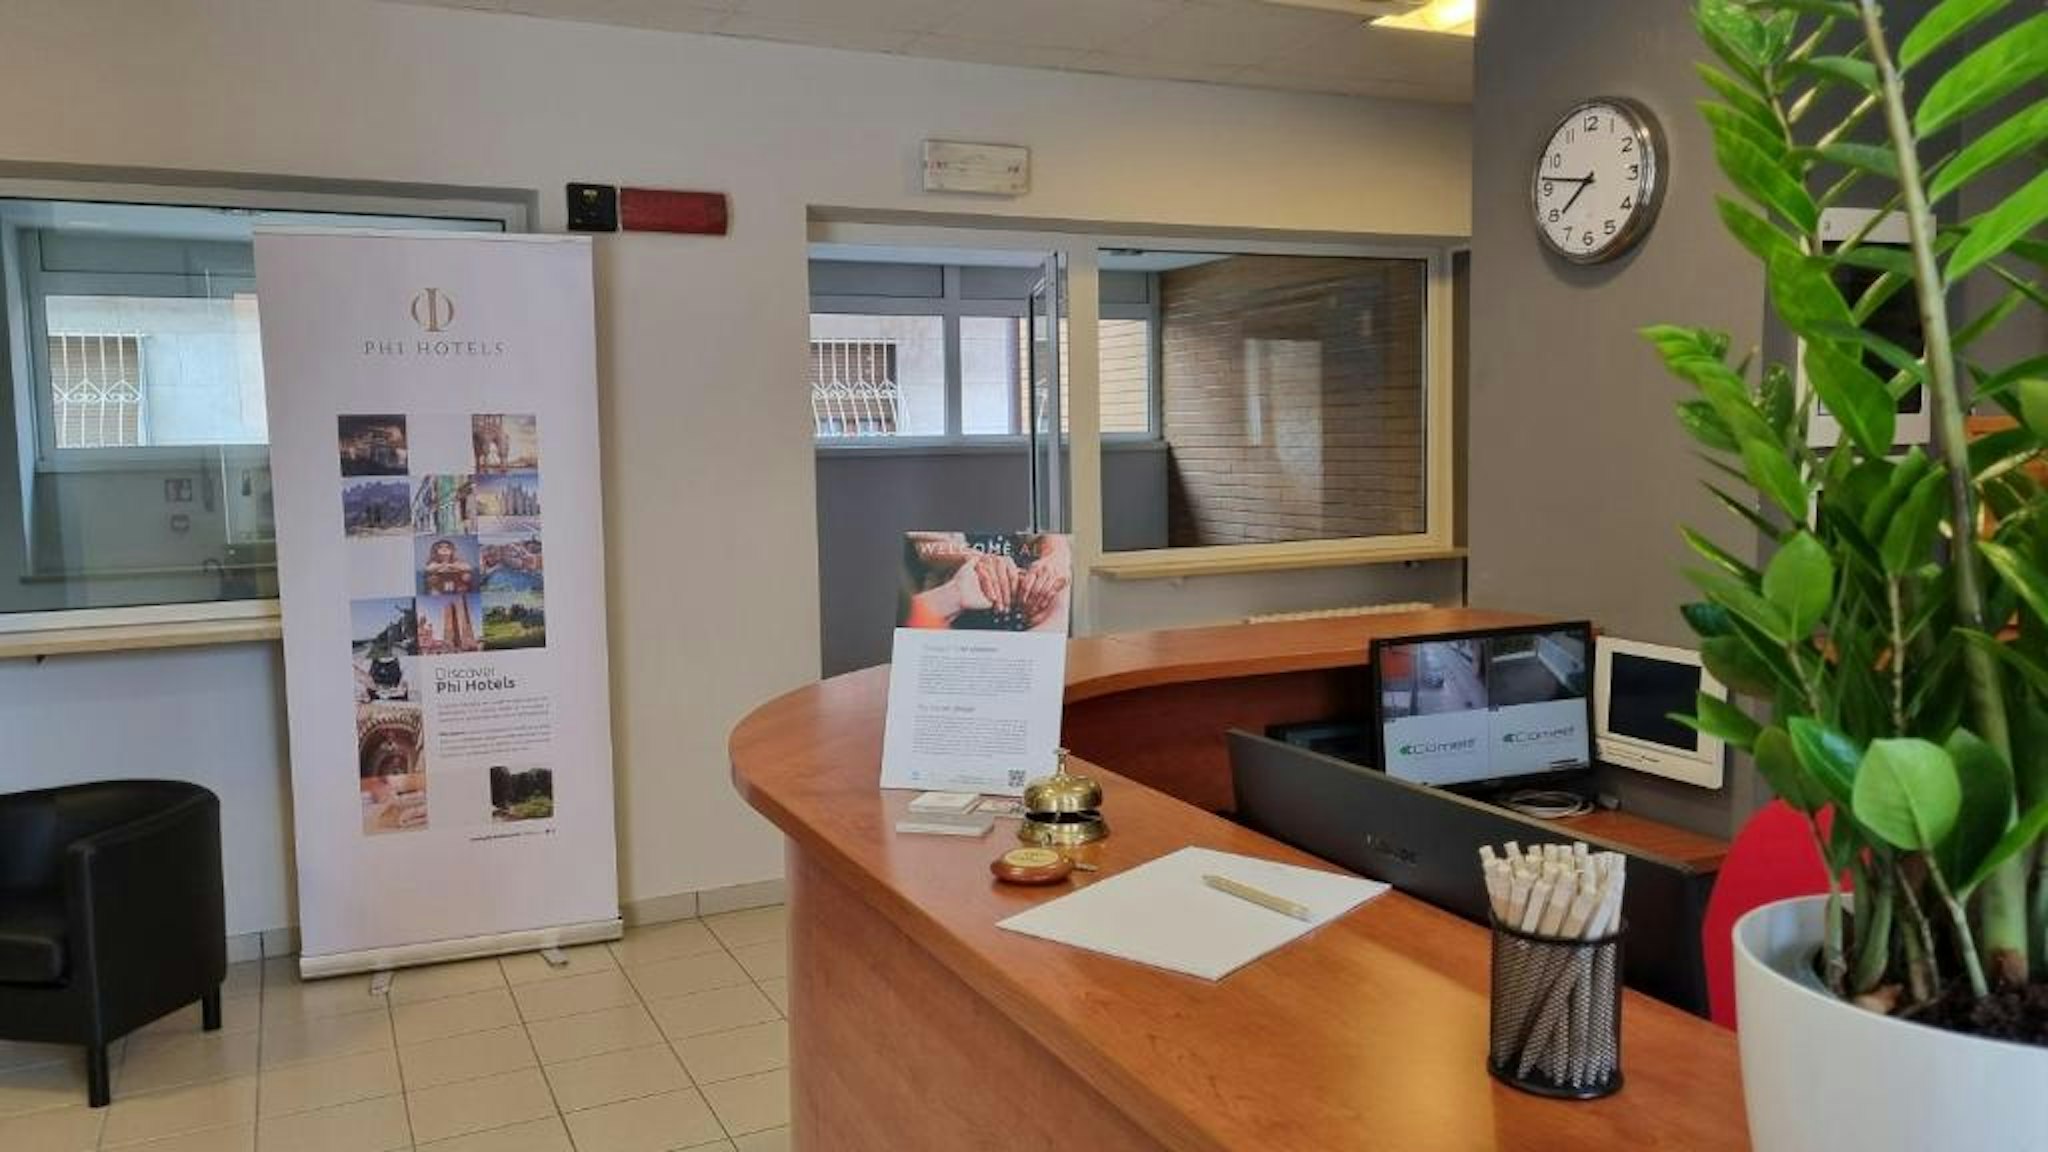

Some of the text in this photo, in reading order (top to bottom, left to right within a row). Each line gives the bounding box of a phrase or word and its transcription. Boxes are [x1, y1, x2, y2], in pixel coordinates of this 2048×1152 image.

[1583, 115, 1599, 133] 12
[1566, 127, 1575, 145] 11
[1621, 136, 1633, 153] 2
[1549, 152, 1561, 169] 10
[1626, 163, 1639, 181] 3
[1543, 181, 1553, 197] 9
[1620, 195, 1632, 209] 4
[1548, 207, 1560, 223] 8
[1562, 225, 1573, 241] 7
[1604, 219, 1617, 235] 5
[1582, 231, 1594, 246] 6
[364, 340, 505, 355] PHI HOTELS
[919, 539, 1012, 556] WELCOME
[435, 667, 495, 680] Discover
[436, 675, 516, 694] Phi Hotels
